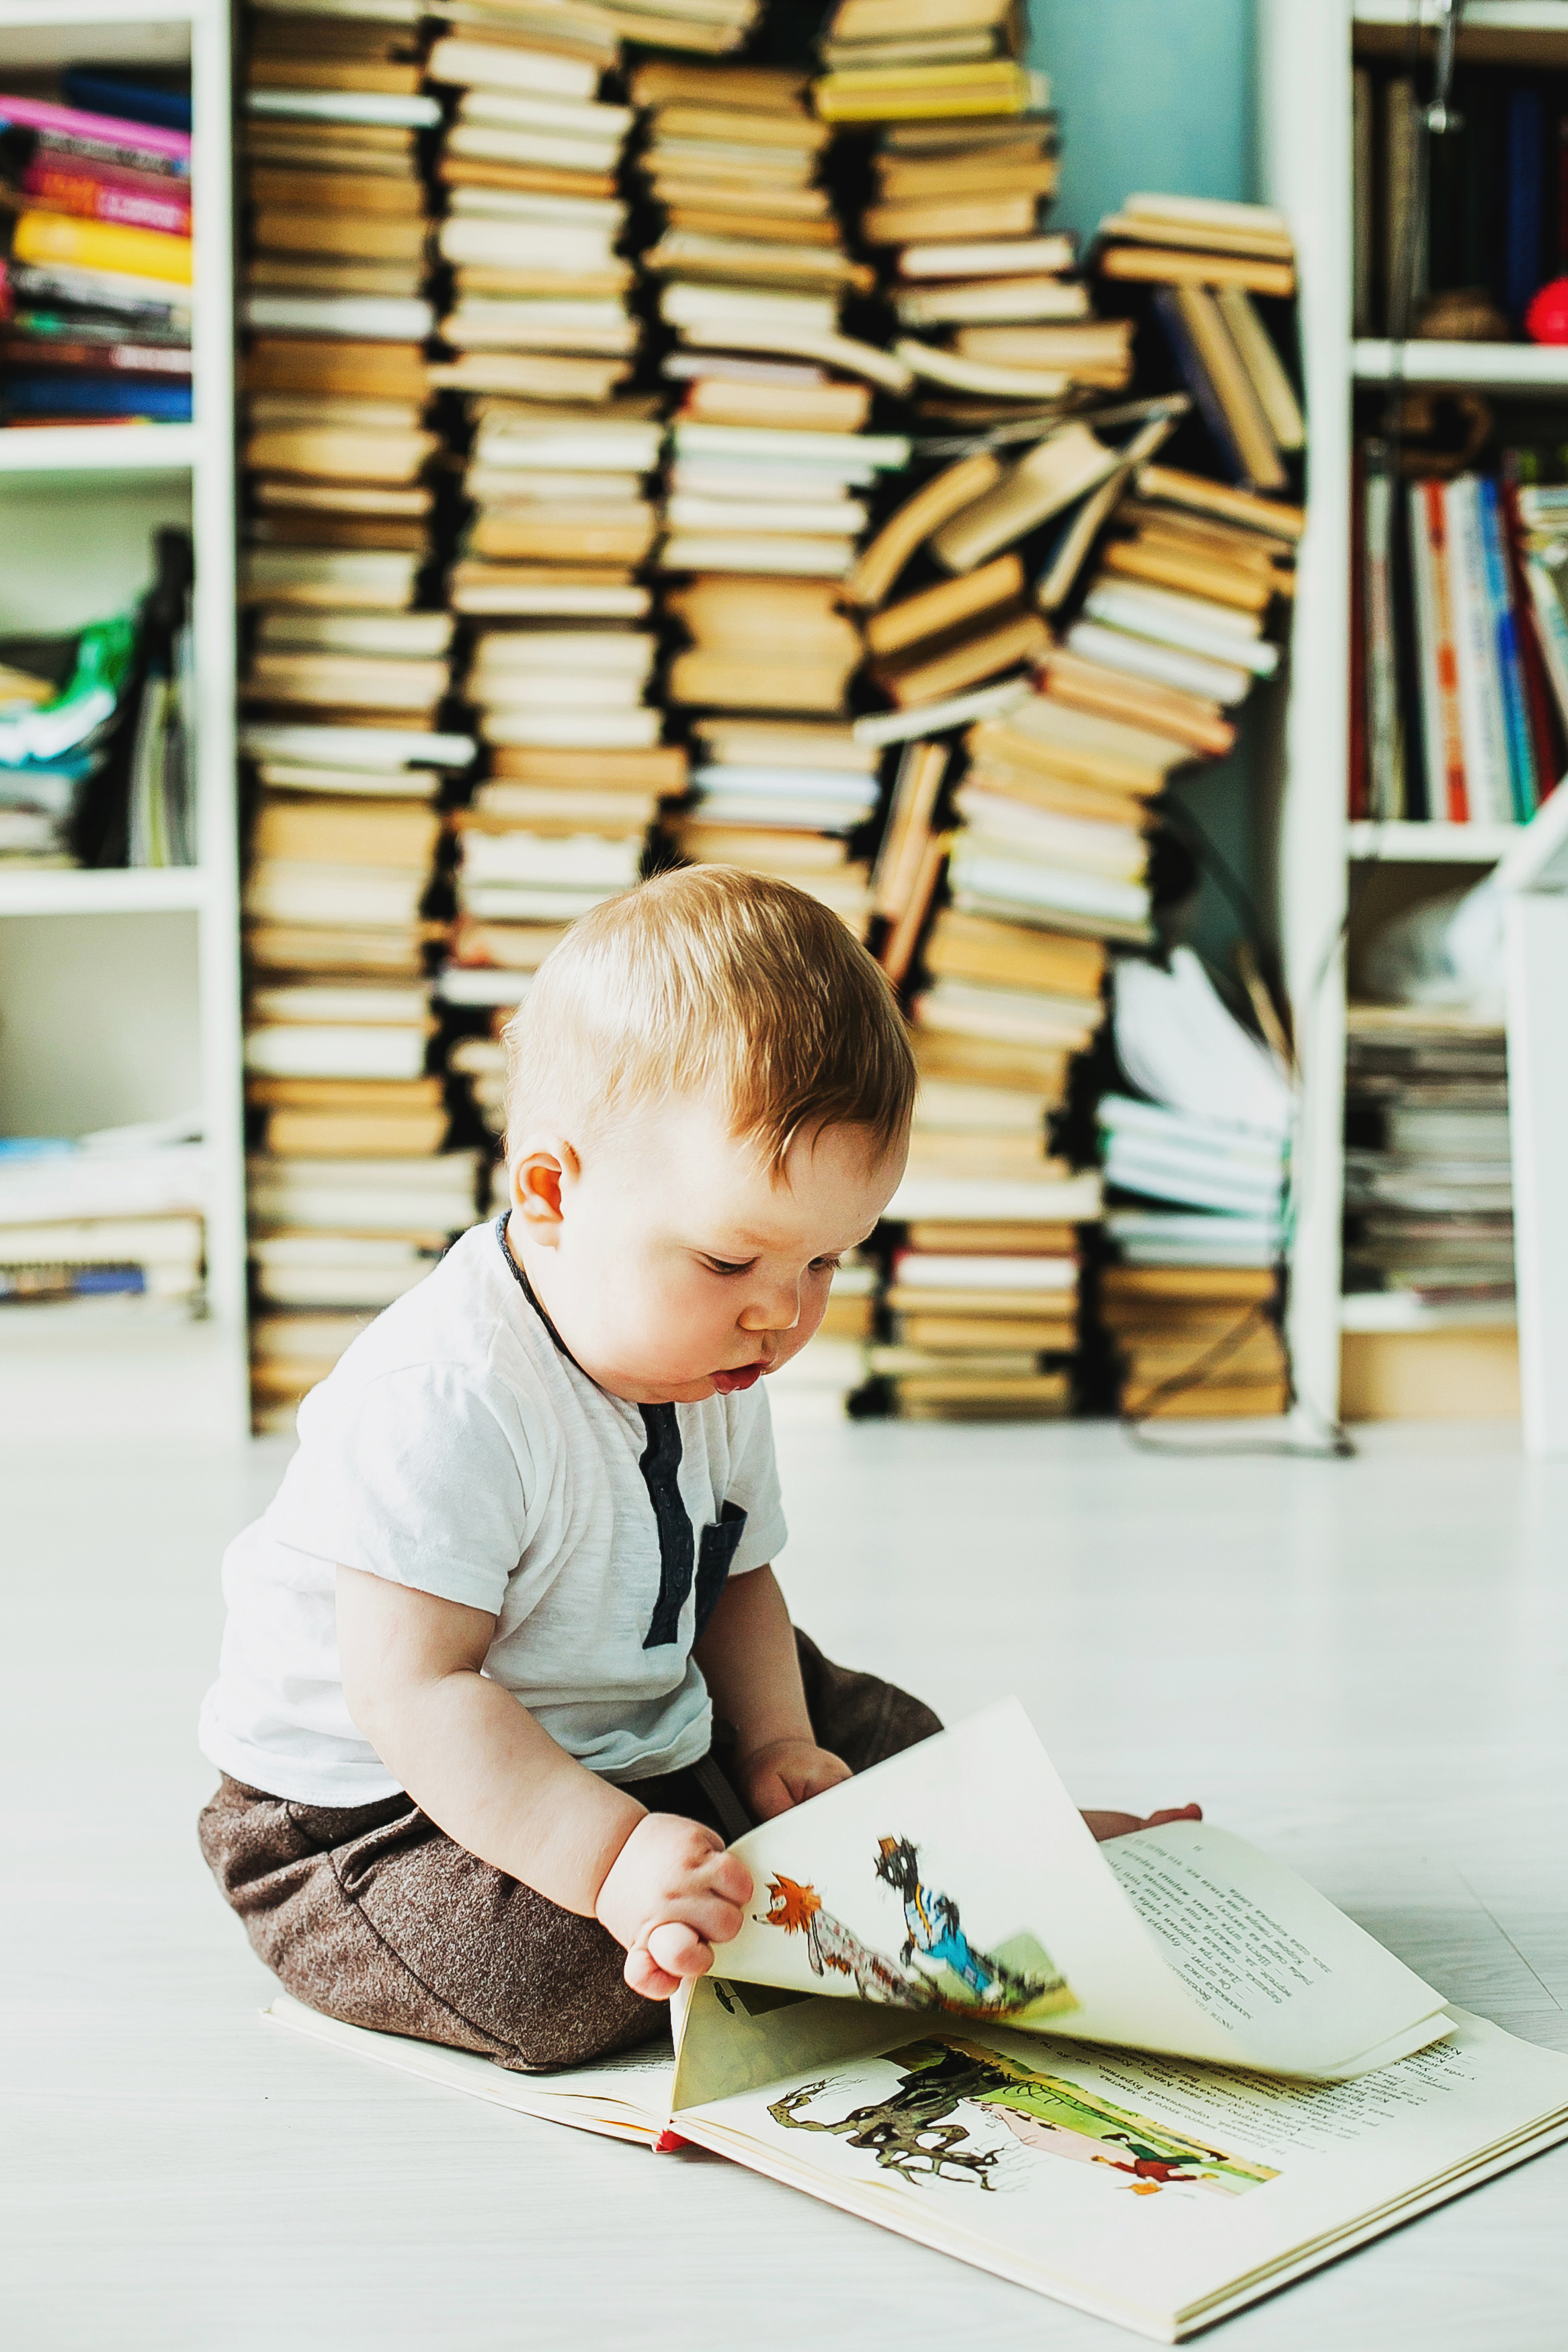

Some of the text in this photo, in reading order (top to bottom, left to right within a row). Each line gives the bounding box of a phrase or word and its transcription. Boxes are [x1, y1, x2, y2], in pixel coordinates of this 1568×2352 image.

[1157, 1871, 1191, 1896] жирных
[1200, 1879, 1227, 1899] взяли
[1137, 1896, 1163, 1916] хлеба
[1192, 1899, 1219, 1920] самых
[1225, 1899, 1243, 1912] они
[1163, 1917, 1198, 1945] корочки
[1219, 1922, 1243, 1941] штук
[1254, 1909, 1290, 1937] корочка
[1147, 1918, 1182, 1947] буркнул
[1203, 1921, 1243, 1955] пожалуй,
[1248, 1932, 1262, 1942] на
[1197, 1947, 1214, 1960] три
[1201, 1936, 1236, 1964] сказала
[1244, 1942, 1272, 1967] Шесть
[1260, 1943, 1288, 1965] сырой
[1273, 1939, 1305, 1966] Короче
[1183, 1961, 1206, 1980] лиса.
[1214, 1961, 1243, 1984] Дайте
[1217, 1978, 1232, 1990] Он
[1038, 2040, 1055, 2050] ты
[1056, 2050, 1072, 2058] же
[1098, 2064, 1145, 2090] Буратино,
[1137, 2066, 1175, 2087] Карло...
[1149, 2067, 1177, 2079] лиса
[1180, 2073, 1202, 2083] Вот
[1403, 2066, 1439, 2082] Пошли
[1443, 2067, 1465, 2078] тебя
[1099, 2073, 1139, 2095] заметил.
[1178, 2078, 1216, 2098] сказала
[1228, 2076, 1280, 2101] проворчал
[1251, 2078, 1288, 2095] ученье
[1323, 2080, 1368, 2096] Базилио
[1382, 2078, 1399, 2086] Вы
[1175, 2086, 1202, 2099] папы
[1286, 2087, 1316, 2099] ветке
[1304, 2085, 1355, 2105] каркнула:
[1364, 2086, 1403, 2099] выдрал
[1370, 2095, 1390, 2103] Кот
[1147, 2090, 1210, 2119] хорошенький
[1155, 2101, 1182, 2114] этого
[1204, 2099, 1225, 2108] для
[1245, 2100, 1262, 2108] это
[1286, 2095, 1338, 2114] проклятое
[1317, 2099, 1347, 2110] сухой
[1184, 2114, 1218, 2130] ничего
[1225, 2108, 1260, 2123] куртку
[1263, 2107, 1294, 2120] добра
